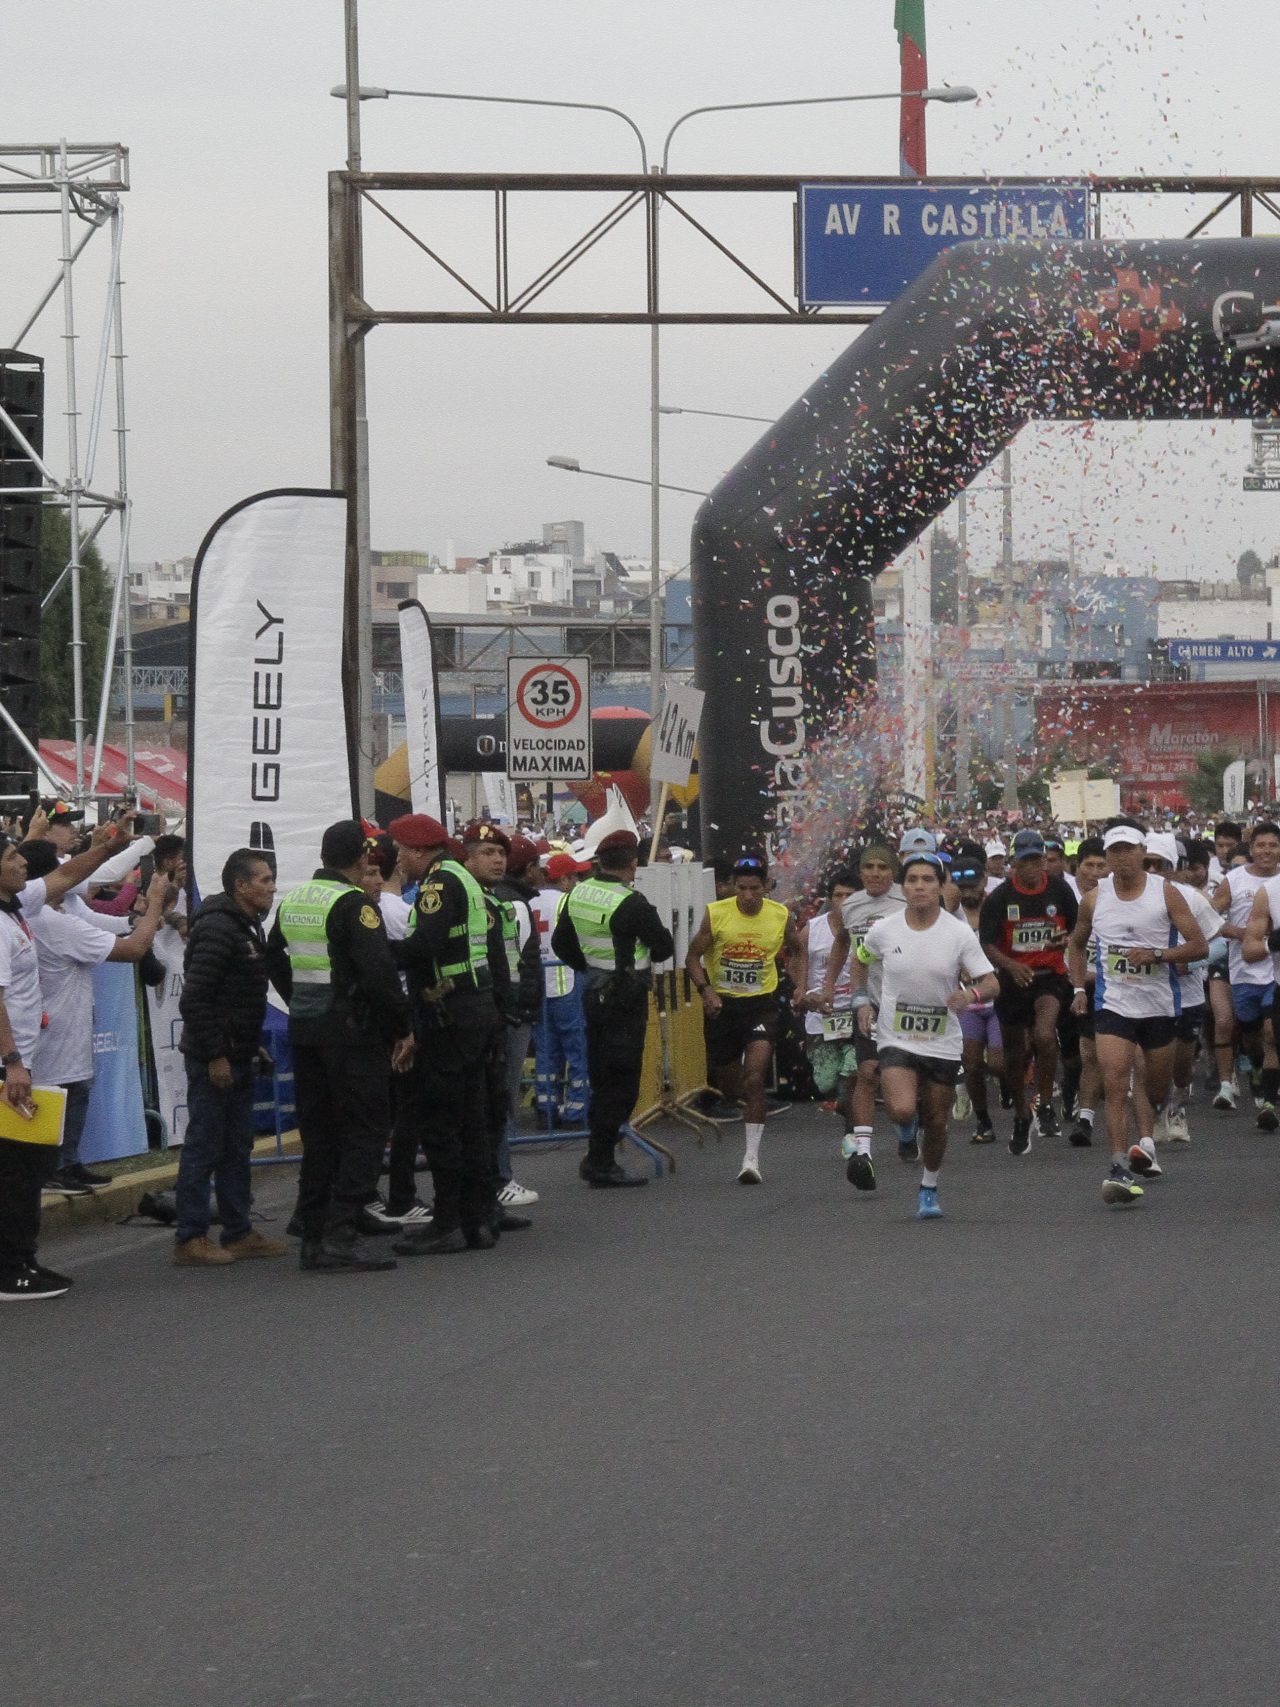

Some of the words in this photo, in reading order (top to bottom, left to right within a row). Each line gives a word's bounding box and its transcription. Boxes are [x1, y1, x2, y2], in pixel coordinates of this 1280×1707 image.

[824, 203, 861, 235] AV
[883, 204, 901, 235] R
[921, 203, 1071, 238] CASTILLA
[1178, 645, 1221, 657] CARMEN
[1227, 645, 1254, 657] ALTO
[251, 598, 284, 801] GEELY
[530, 680, 570, 706] 35
[535, 707, 566, 717] KPH
[660, 700, 679, 753] 42
[759, 594, 808, 866] ajaCusco
[513, 738, 586, 751] VELOCIDAD
[512, 756, 586, 773] MAXIMA
[576, 886, 614, 906] OLICIA
[1018, 929, 1052, 944] 094
[725, 970, 757, 983] 136
[900, 1015, 941, 1032] 037
